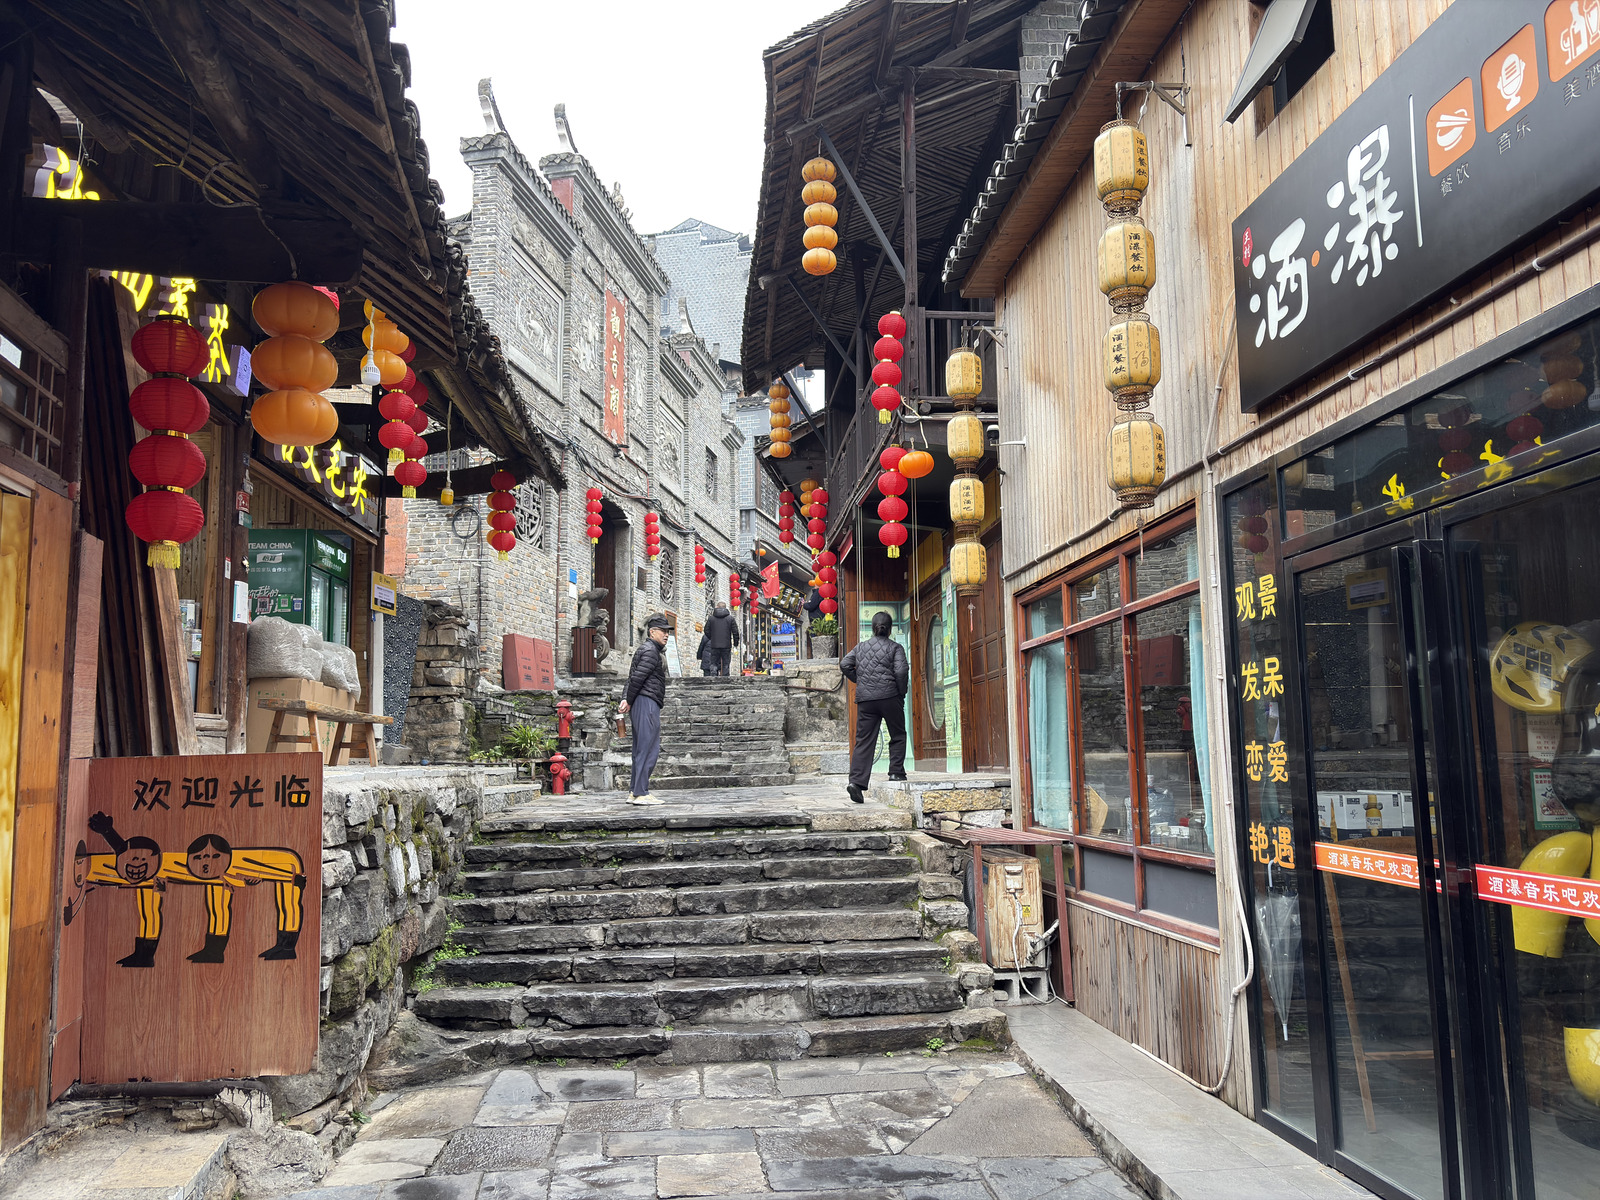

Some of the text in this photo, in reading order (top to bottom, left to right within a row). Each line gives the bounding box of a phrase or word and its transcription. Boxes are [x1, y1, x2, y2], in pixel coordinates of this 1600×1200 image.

[1497, 114, 1532, 155] 音乐
[1440, 162, 1470, 197] 餐饮
[1235, 574, 1278, 622] 观景
[1241, 656, 1284, 702] 发呆
[1245, 740, 1289, 783] 恋爱
[132, 774, 311, 811] 欢迎光临
[1249, 821, 1295, 870] 艳遇
[1488, 876, 1600, 910] 酒瀑音乐吧欢
